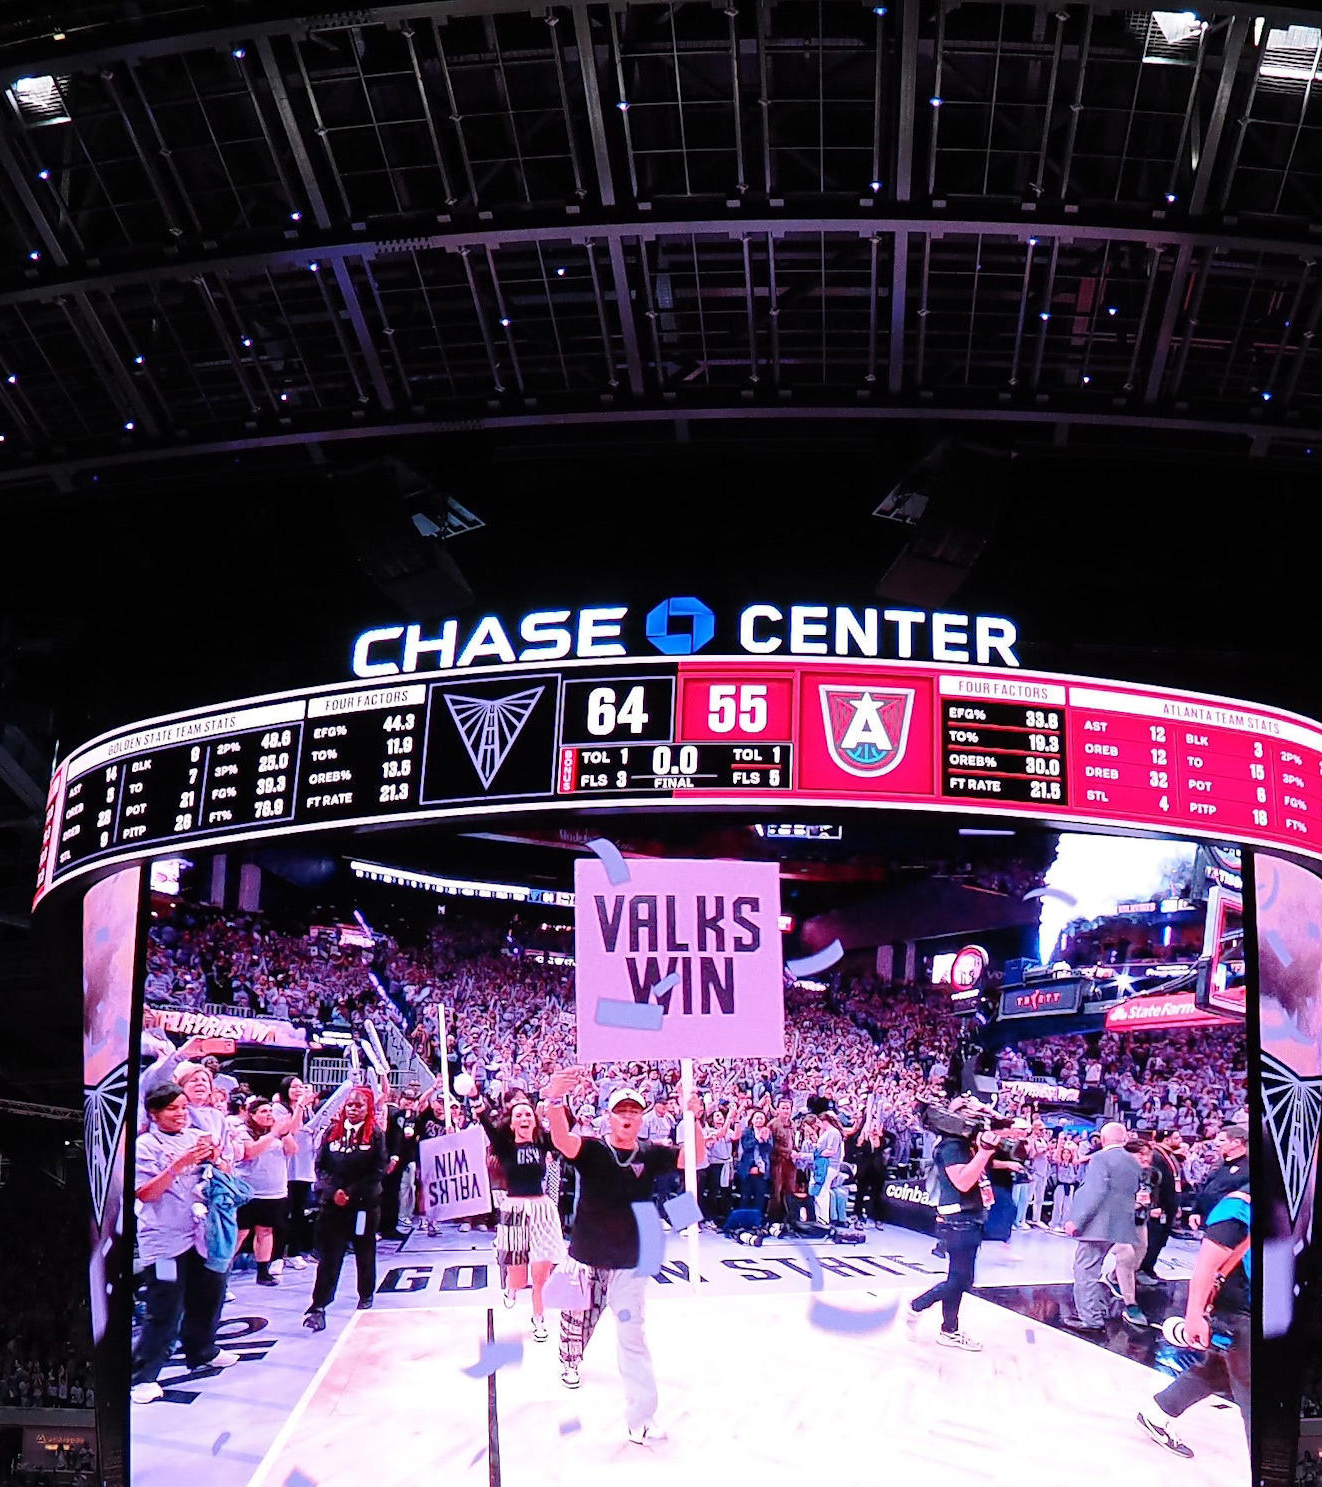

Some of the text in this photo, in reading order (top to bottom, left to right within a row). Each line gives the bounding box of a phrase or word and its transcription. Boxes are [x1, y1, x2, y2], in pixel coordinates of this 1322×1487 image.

[352, 605, 1021, 678] CHASE CENTER
[325, 690, 408, 711] FOUR FACTORS
[959, 680, 1048, 700] FOUR FACTORS
[588, 686, 648, 735] 64
[708, 685, 767, 732] 55
[949, 707, 986, 720] EFG%
[1163, 703, 1280, 735] ATLANTA TEAM STATS
[383, 714, 415, 731] 44.3
[1084, 721, 1166, 742] AST 12
[108, 717, 236, 755] GOLDEN STATE TEAM STATS
[949, 731, 1059, 752] TO% 19.3
[1186, 734, 1263, 757] BLK 3
[217, 742, 241, 754] 2P%
[312, 749, 337, 761] TO%
[582, 748, 628, 764] TOL 1
[733, 746, 780, 763] TOL 1
[1085, 744, 1167, 765] OREB 12
[1281, 751, 1302, 765] 2P%
[258, 753, 289, 772] 25.0
[652, 746, 698, 775] 0.0
[949, 754, 1059, 775] OREB% 30.0
[1187, 757, 1264, 780] TO 15
[129, 768, 198, 793] TO 7
[309, 770, 351, 784] OREB%
[581, 771, 627, 787] FLS 3
[654, 778, 694, 788] FINAL
[733, 770, 780, 786] FLS 5
[950, 778, 965, 789] FT
[968, 779, 1001, 792] RATE
[1086, 767, 1168, 788] DREB 32
[1189, 779, 1212, 791] POT
[212, 776, 286, 800] FG% 39.3
[307, 783, 408, 808] FT RATE 21.3
[126, 791, 194, 816] POT 21
[1087, 790, 1169, 811] STL 4
[1190, 803, 1216, 814] PITP
[1285, 796, 1307, 810] FG%
[209, 810, 232, 823] FT%
[1286, 819, 1307, 832] FT%
[594, 895, 760, 953] VALKS
[626, 956, 734, 1016] WIN
